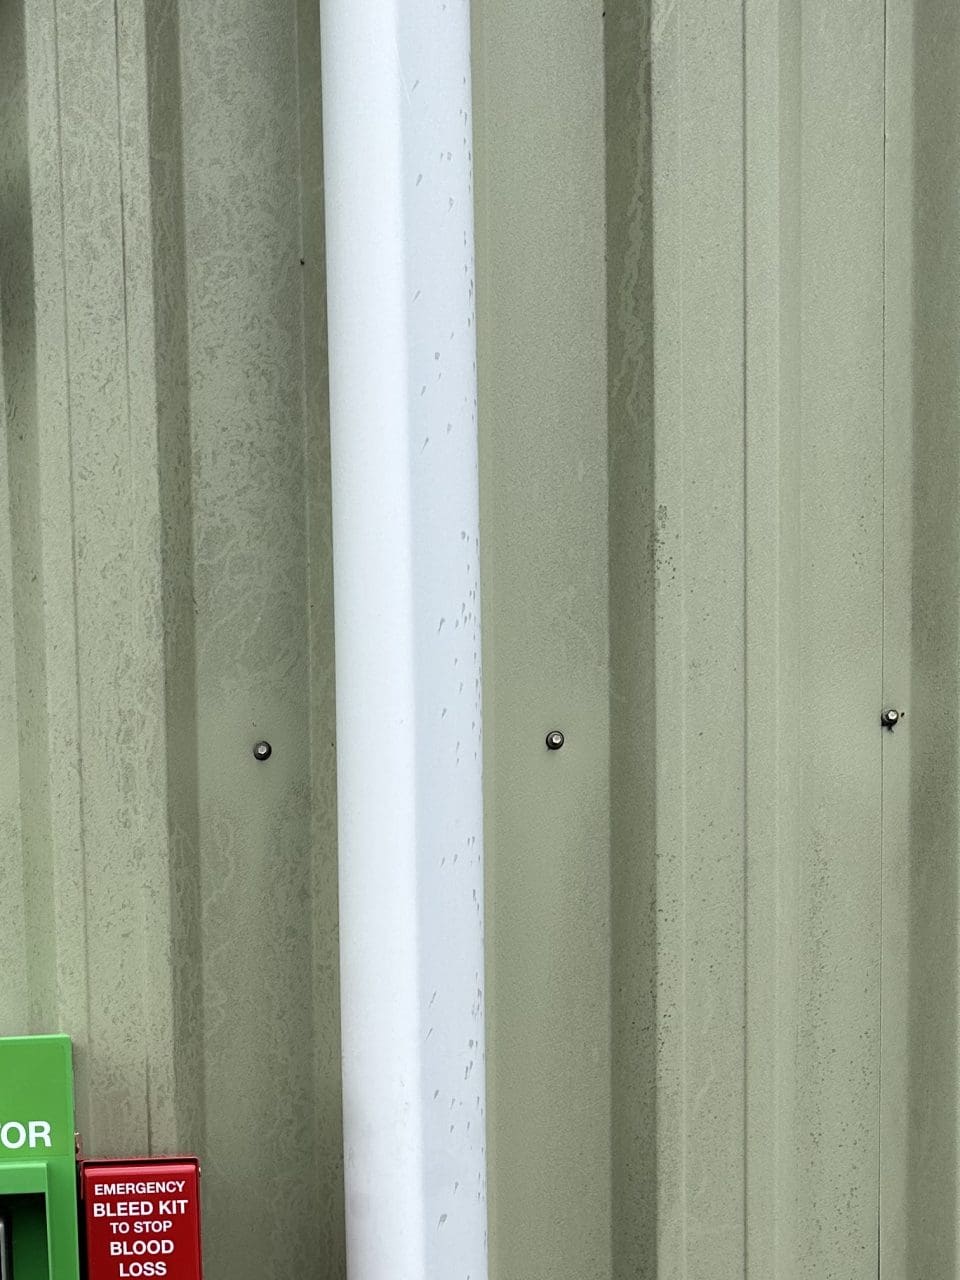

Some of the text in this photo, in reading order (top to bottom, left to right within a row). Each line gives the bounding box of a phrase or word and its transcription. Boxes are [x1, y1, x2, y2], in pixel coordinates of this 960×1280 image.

[94, 1181, 186, 1196] EMERGENCY
[93, 1200, 189, 1217] BLEED KIT
[109, 1220, 173, 1234] TO STOP
[110, 1240, 175, 1256] BLOOD
[119, 1262, 167, 1277] LOSS
